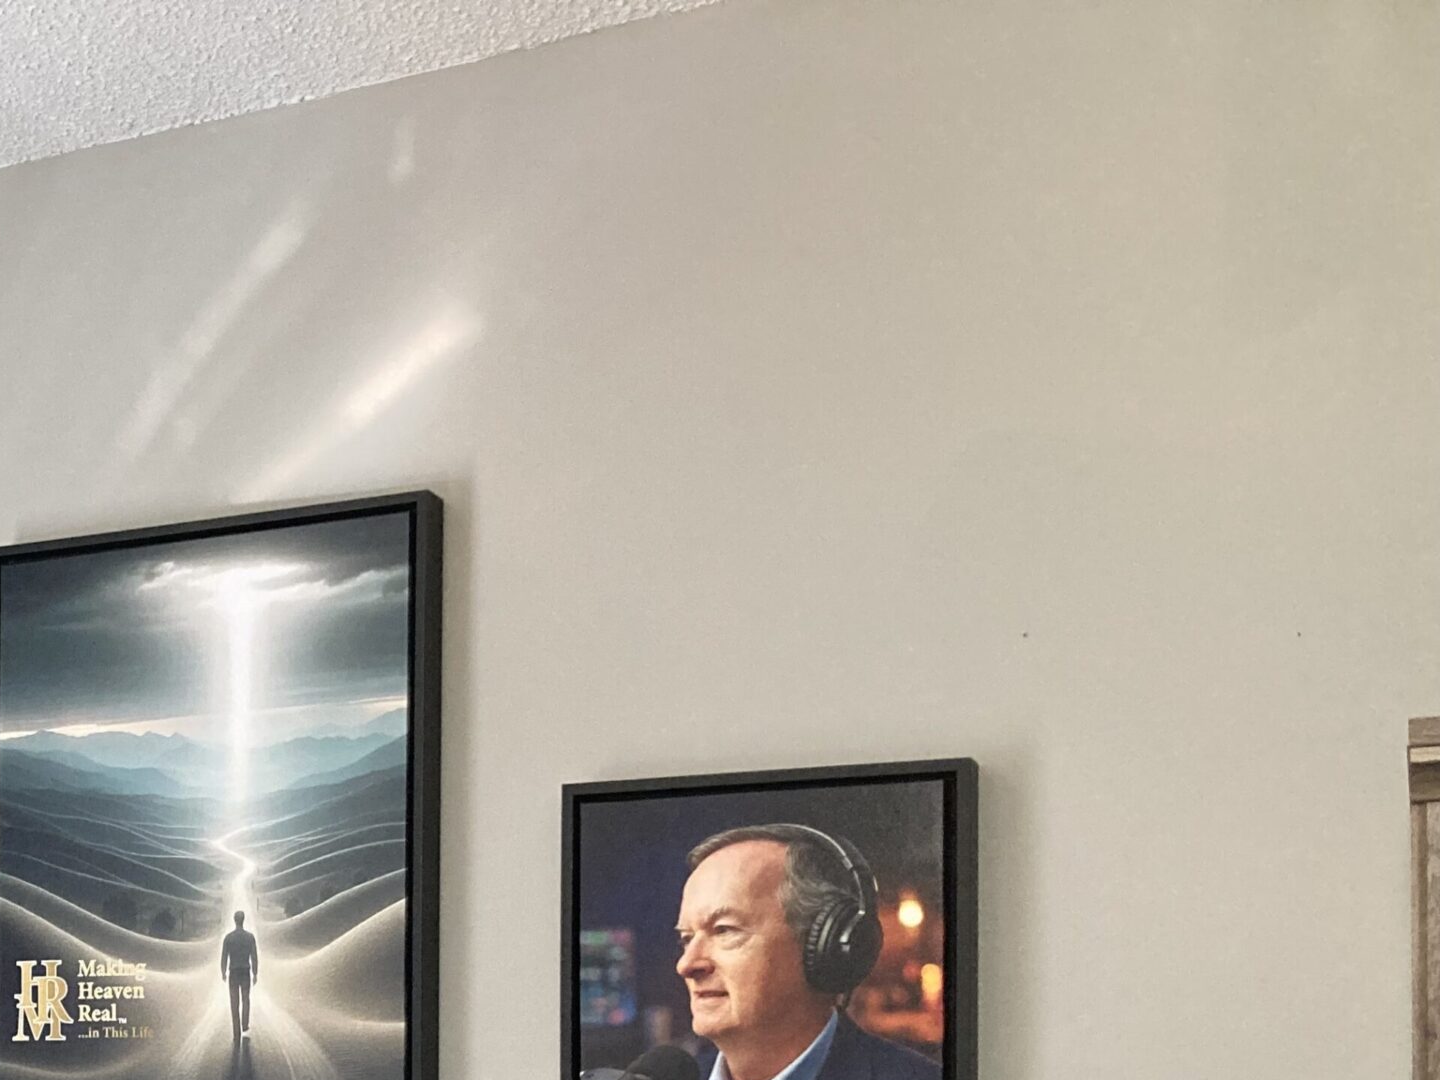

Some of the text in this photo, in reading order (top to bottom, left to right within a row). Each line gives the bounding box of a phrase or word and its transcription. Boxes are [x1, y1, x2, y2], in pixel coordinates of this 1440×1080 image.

[77, 959, 147, 981] Making
[78, 982, 145, 1000] Heaven
[78, 1003, 117, 1022] Real
[103, 1027, 129, 1039] This
[132, 1026, 155, 1039] Life
